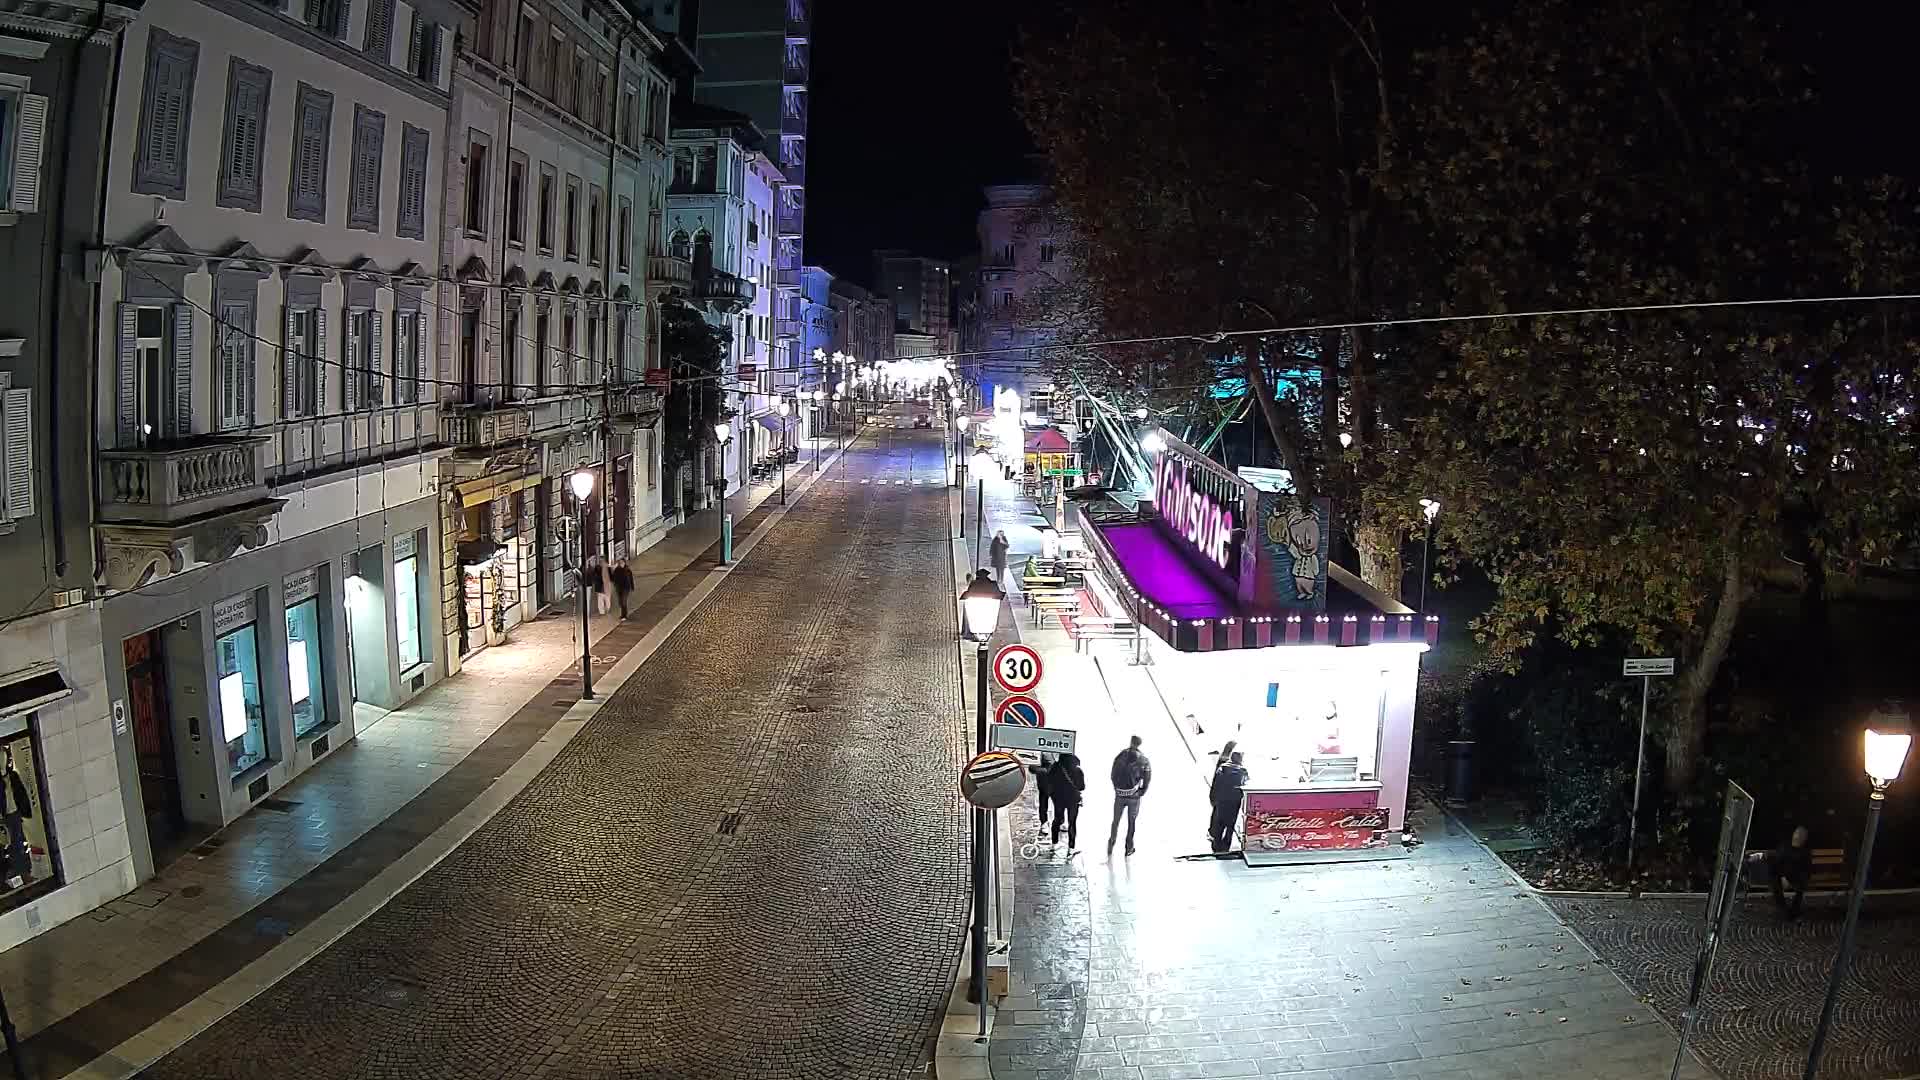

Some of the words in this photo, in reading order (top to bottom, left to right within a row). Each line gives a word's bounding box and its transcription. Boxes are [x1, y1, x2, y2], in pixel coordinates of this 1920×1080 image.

[1162, 454, 1232, 569] Golosone
[1005, 658, 1033, 680] 30
[1038, 737, 1070, 749] Dante
